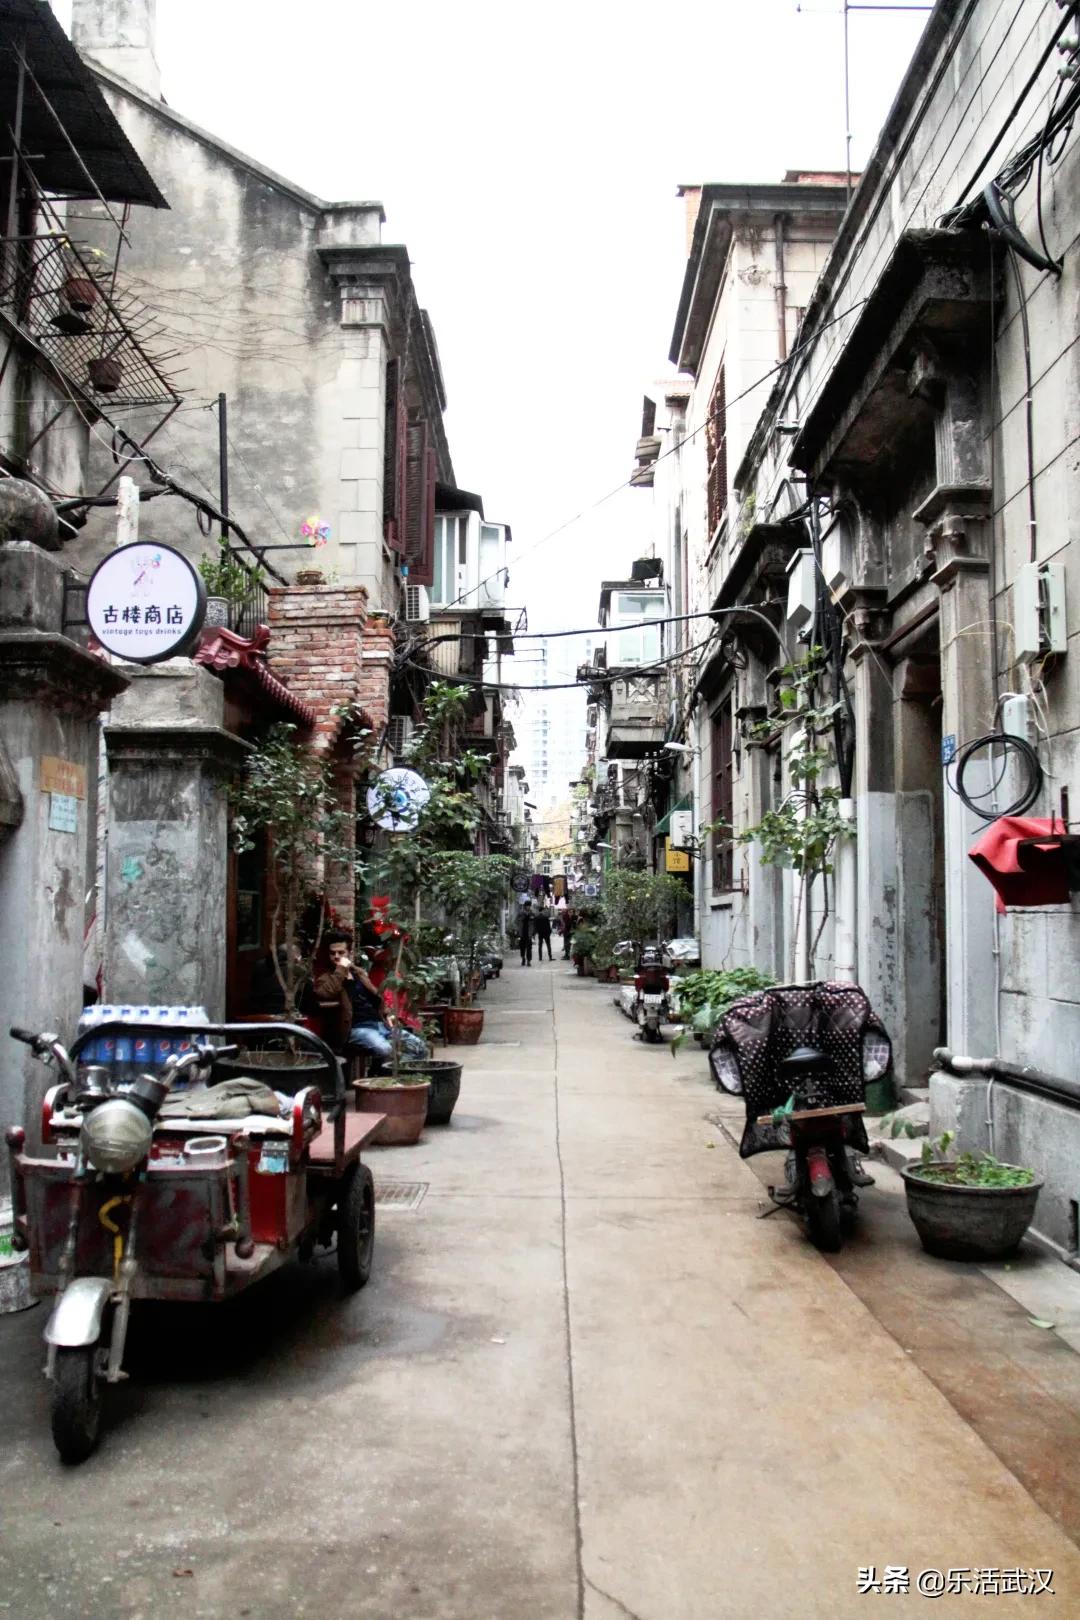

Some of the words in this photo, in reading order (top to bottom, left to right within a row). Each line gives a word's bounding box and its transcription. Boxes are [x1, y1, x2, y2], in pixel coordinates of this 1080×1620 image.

[103, 604, 183, 624] 古楼商店
[102, 628, 133, 636] vintage
[135, 628, 153, 636] toys
[155, 627, 182, 635] drinks
